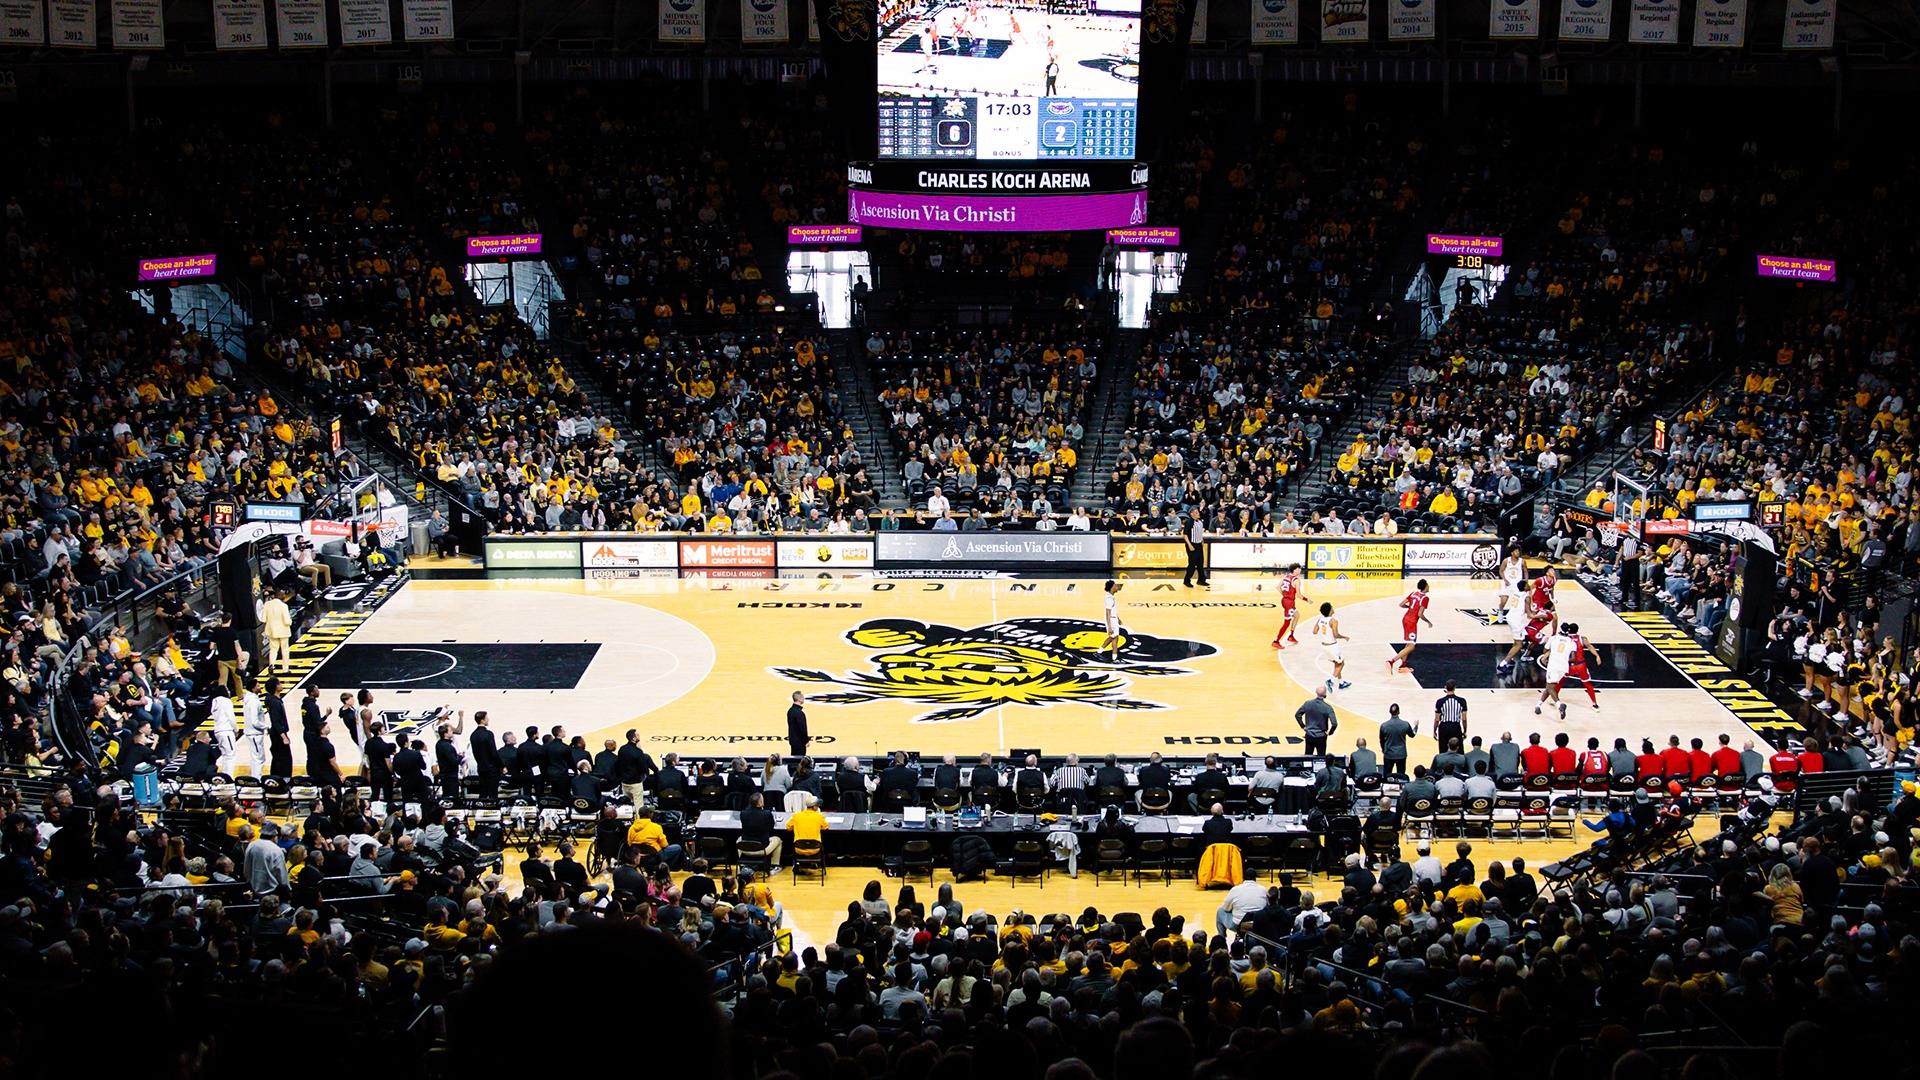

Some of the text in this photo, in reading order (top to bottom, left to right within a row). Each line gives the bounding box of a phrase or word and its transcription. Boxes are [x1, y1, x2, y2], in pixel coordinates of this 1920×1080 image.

[1634, 4, 1677, 13] Indianapolis
[1639, 14, 1670, 23] Regional
[1718, 11, 1737, 19] Diego
[1791, 11, 1831, 19] Indianapolis
[1393, 16, 1430, 24] REGIONAL
[1565, 16, 1606, 24] REGIONAL
[419, 26, 439, 35] 2021
[672, 26, 691, 36] 1964
[756, 27, 775, 36] 1965
[1337, 27, 1356, 36] 2013
[1402, 25, 1421, 33] 2014
[1504, 24, 1524, 32] 2015
[1574, 25, 1594, 34] 2016
[9, 28, 30, 38] 2006
[64, 31, 83, 41] 2012
[129, 33, 149, 42] 2014
[294, 32, 313, 41] 2016
[357, 29, 376, 38] 2017
[1643, 31, 1664, 39] 2017
[1709, 33, 1729, 42] 2018
[231, 33, 252, 43] 2015
[1797, 33, 1818, 43] 2021
[397, 65, 422, 80] 105
[781, 63, 807, 77] 107
[986, 104, 1032, 116] 17:03
[1088, 110, 1092, 118] 1
[1106, 110, 1111, 118] 0
[1124, 110, 1130, 118] 0
[1087, 119, 1092, 127] 2
[1106, 119, 1111, 127] 0
[1124, 119, 1129, 127] 0
[949, 125, 961, 142] 6
[1055, 126, 1066, 142] 2
[1086, 129, 1093, 137] 11
[1106, 129, 1111, 137] 0
[1124, 129, 1129, 137] 0
[1105, 138, 1110, 146] 0
[1124, 138, 1129, 146] 0
[918, 171, 1091, 189] CHARLES KOCH ARENA
[860, 201, 1016, 222] Ascension Via Christi
[1430, 236, 1459, 246] Choose
[1470, 239, 1499, 247] all-star
[481, 246, 505, 254] heart
[1441, 245, 1488, 254] heart team
[143, 262, 172, 271] Choose
[185, 258, 213, 267] all-star
[1457, 255, 1482, 268] 3:08
[1760, 258, 1790, 268] Choose
[1802, 262, 1832, 271] all-star
[153, 267, 201, 277] heart team
[1772, 267, 1820, 278] heart team
[264, 508, 293, 517] KOCH
[1713, 507, 1743, 516] KOCH
[215, 514, 231, 523] 21
[1765, 513, 1780, 523] 21
[711, 544, 773, 557] Meritrust
[966, 542, 1082, 553] Ascension Via Christi
[1357, 545, 1398, 553] BlueCross
[506, 550, 575, 559] DELTA DENTAL
[1137, 551, 1173, 561] EQUITY
[1356, 553, 1401, 561] BlueShield
[1419, 550, 1468, 560] JumpStart
[1473, 550, 1497, 561] BETTER
[1411, 599, 1416, 609] 1
[288, 611, 374, 652] STATE
[985, 624, 1061, 646] WSU
[1615, 611, 1732, 674] WICHITA
[1557, 643, 1566, 654] 0
[1696, 679, 1807, 731] STATE
[1164, 736, 1281, 745] KOCH
[1593, 758, 1602, 770] 3
